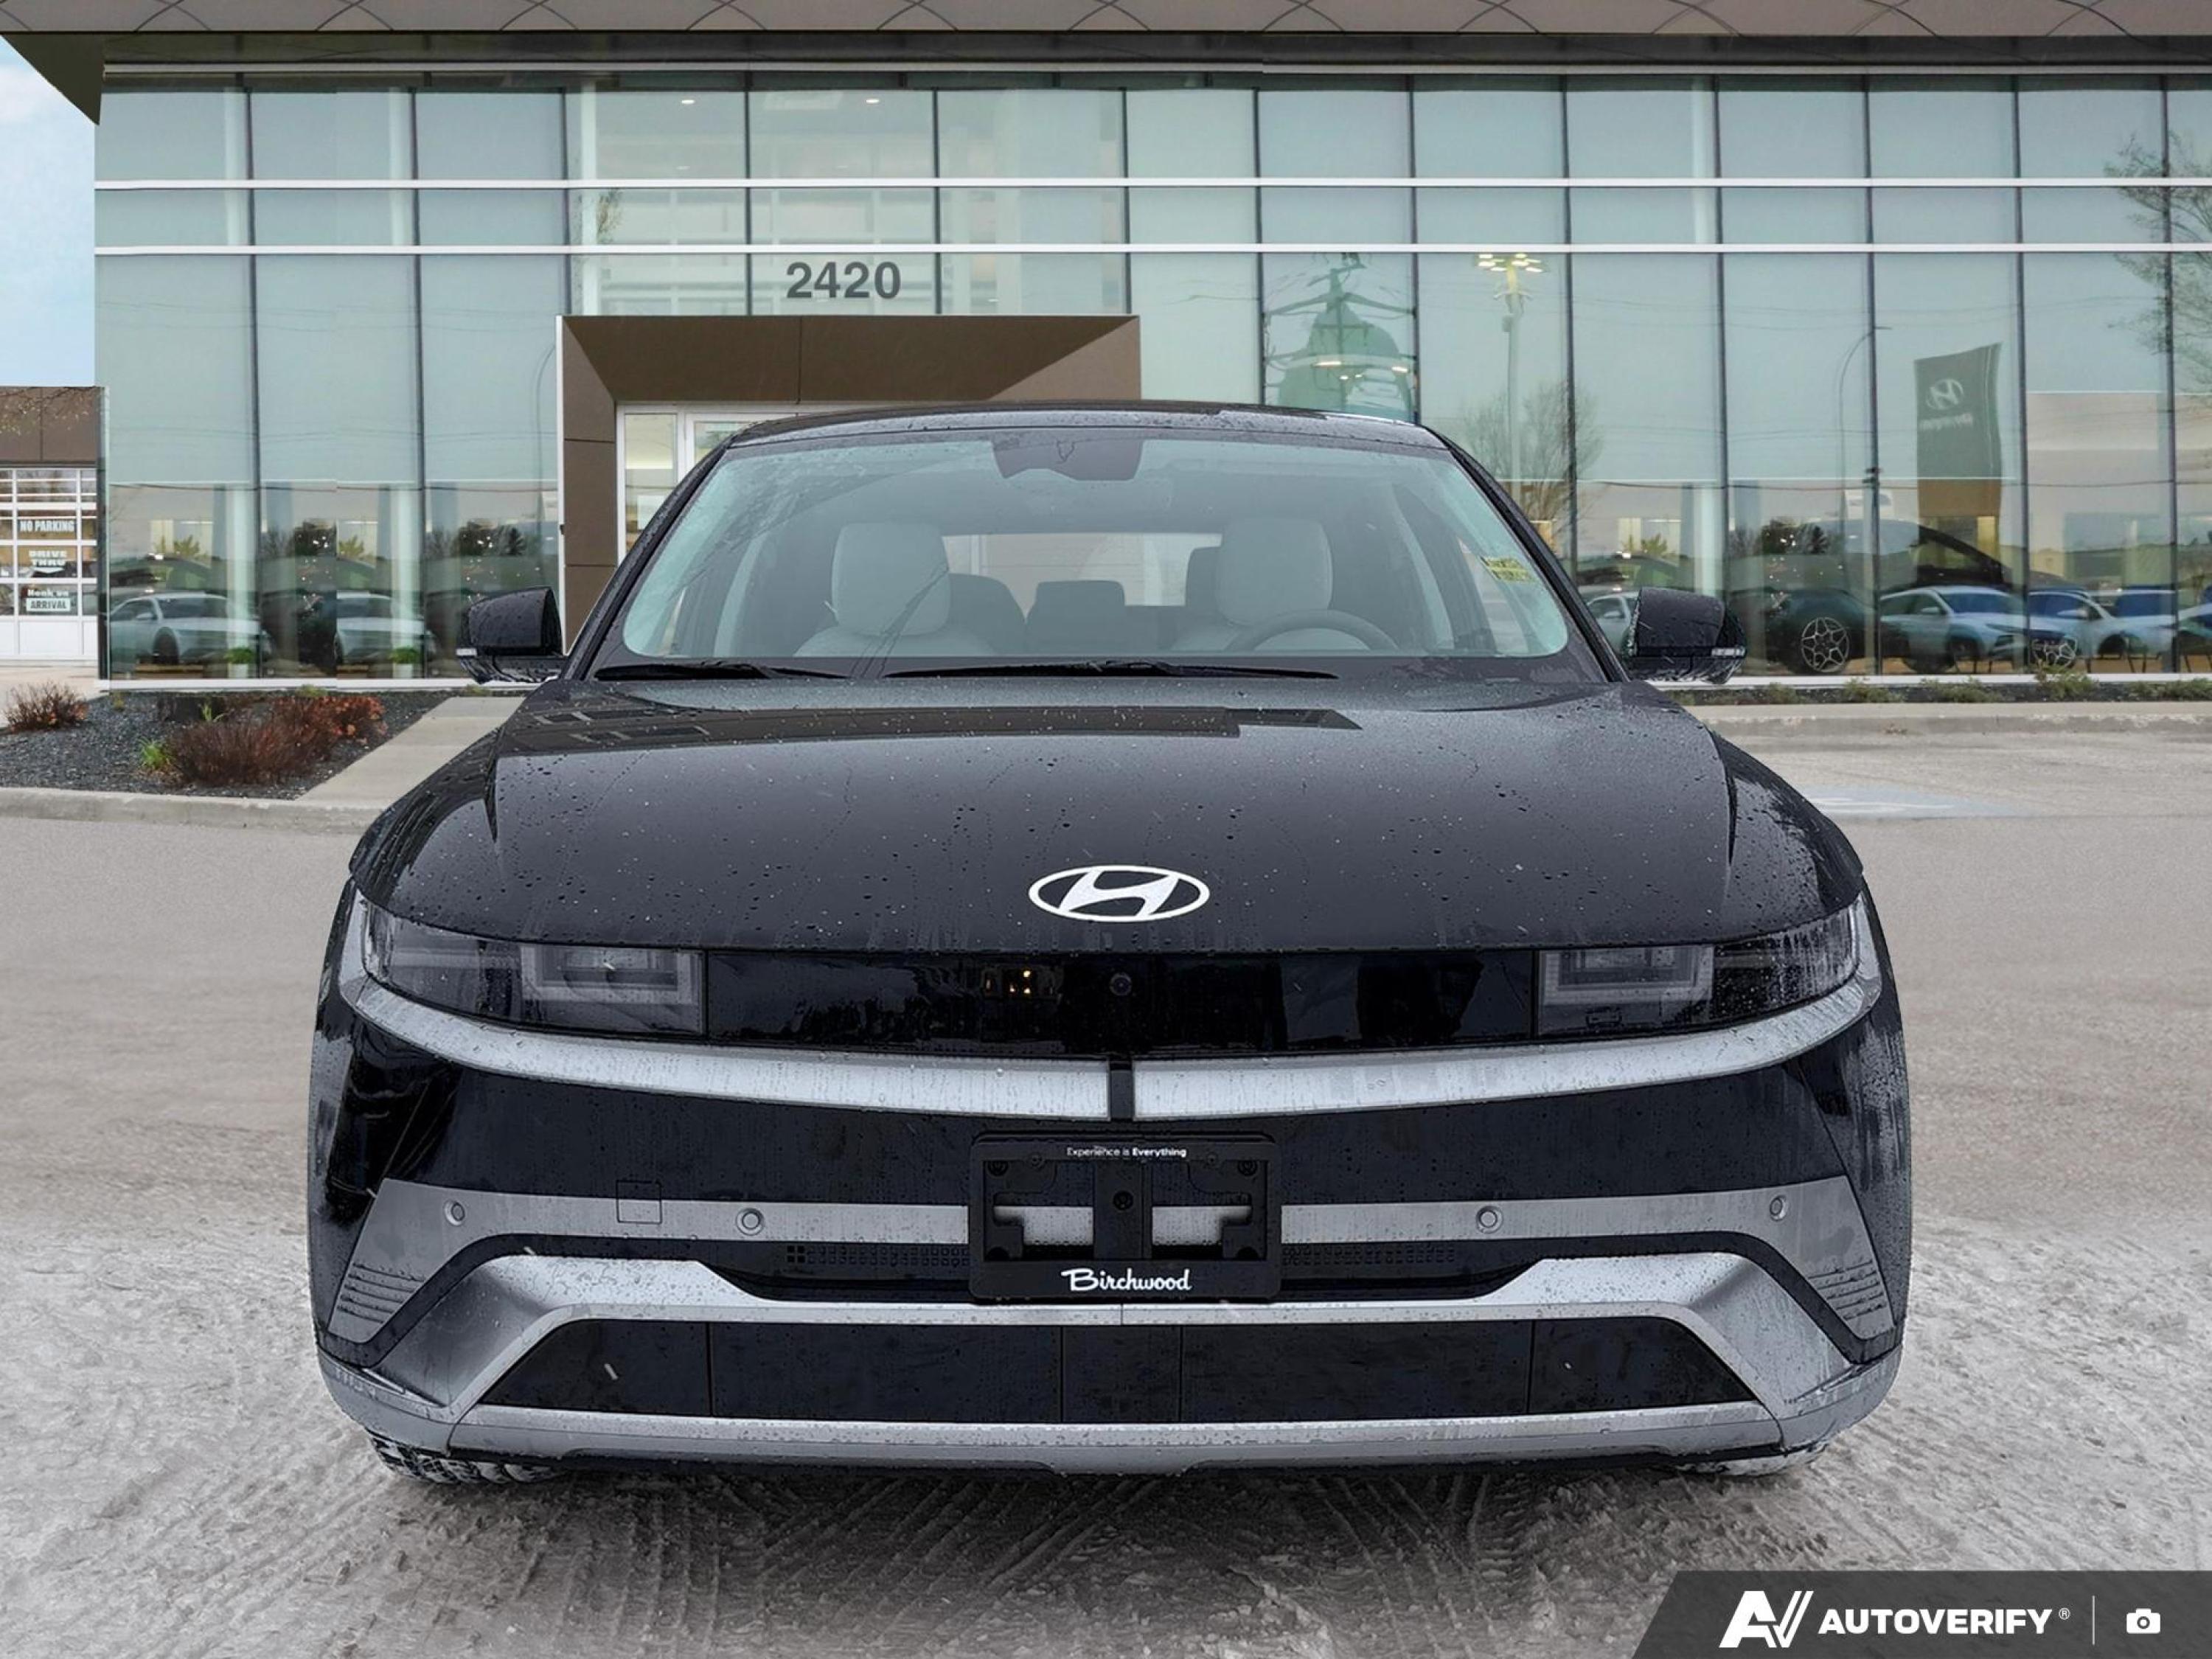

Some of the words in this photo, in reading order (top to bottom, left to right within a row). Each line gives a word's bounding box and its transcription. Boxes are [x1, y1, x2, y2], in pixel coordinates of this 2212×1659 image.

[787, 261, 901, 299] 2420
[20, 520, 33, 532] NO
[35, 520, 74, 532] PARKING
[29, 550, 67, 558] DRIVE
[30, 600, 67, 609] ARRIVAL
[1066, 1145, 1121, 1158] Experience
[1132, 1146, 1188, 1158] Everything
[1060, 1267, 1192, 1292] Birchwood
